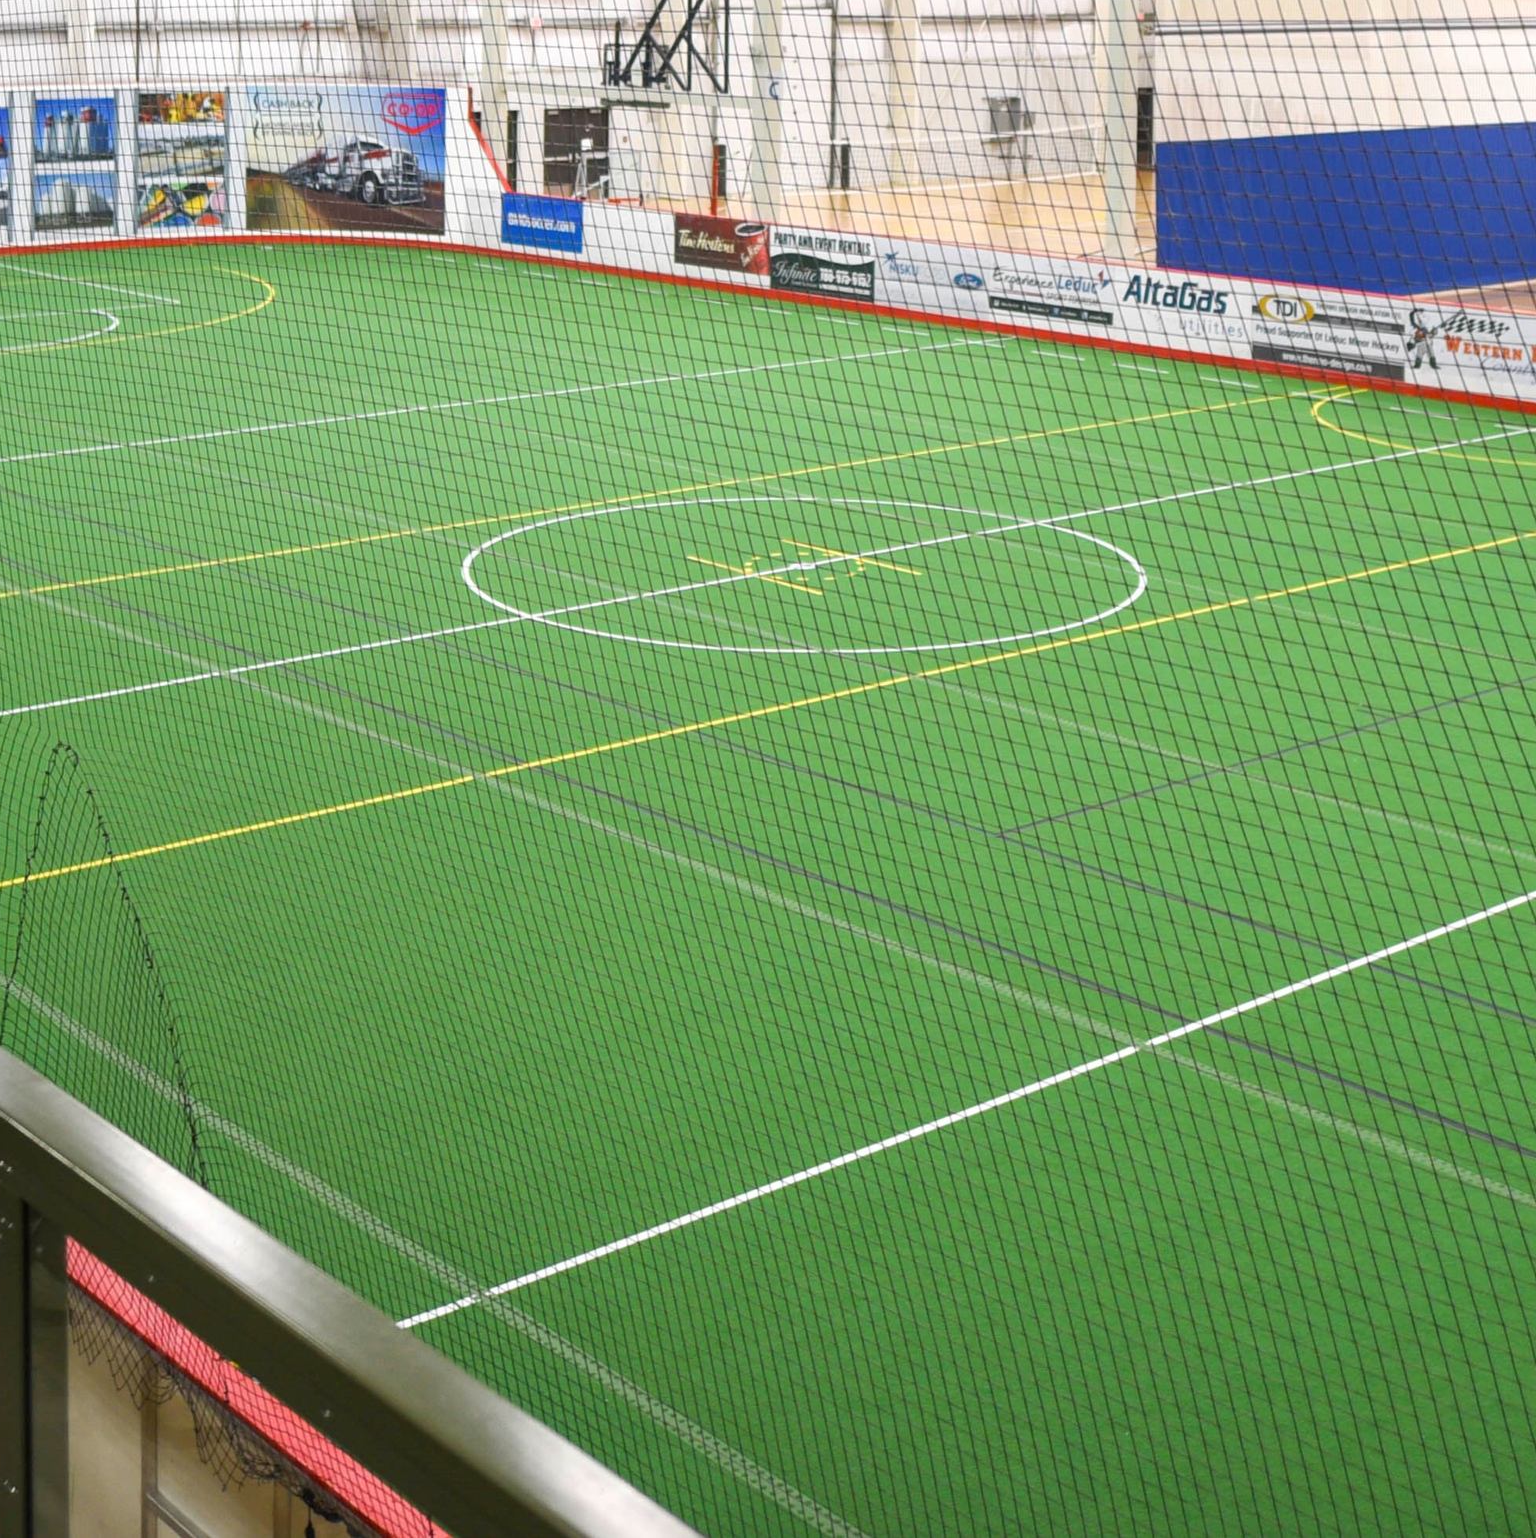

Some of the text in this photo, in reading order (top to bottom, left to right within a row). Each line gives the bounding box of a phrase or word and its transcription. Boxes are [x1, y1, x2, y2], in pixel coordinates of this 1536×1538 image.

[678, 229, 698, 249] Tim
[697, 230, 735, 253] Hortons
[774, 232, 871, 255] PARTY AND EVENT RENTALS
[889, 263, 919, 276] NISKU
[992, 267, 1098, 294] Experience Leduc
[1123, 275, 1228, 313] AltaGas
[1274, 300, 1297, 318] TDI
[1256, 324, 1276, 334] Proud
[1324, 334, 1346, 343] Leduc
[1349, 337, 1369, 347] Minor
[1372, 339, 1399, 353] Hockey
